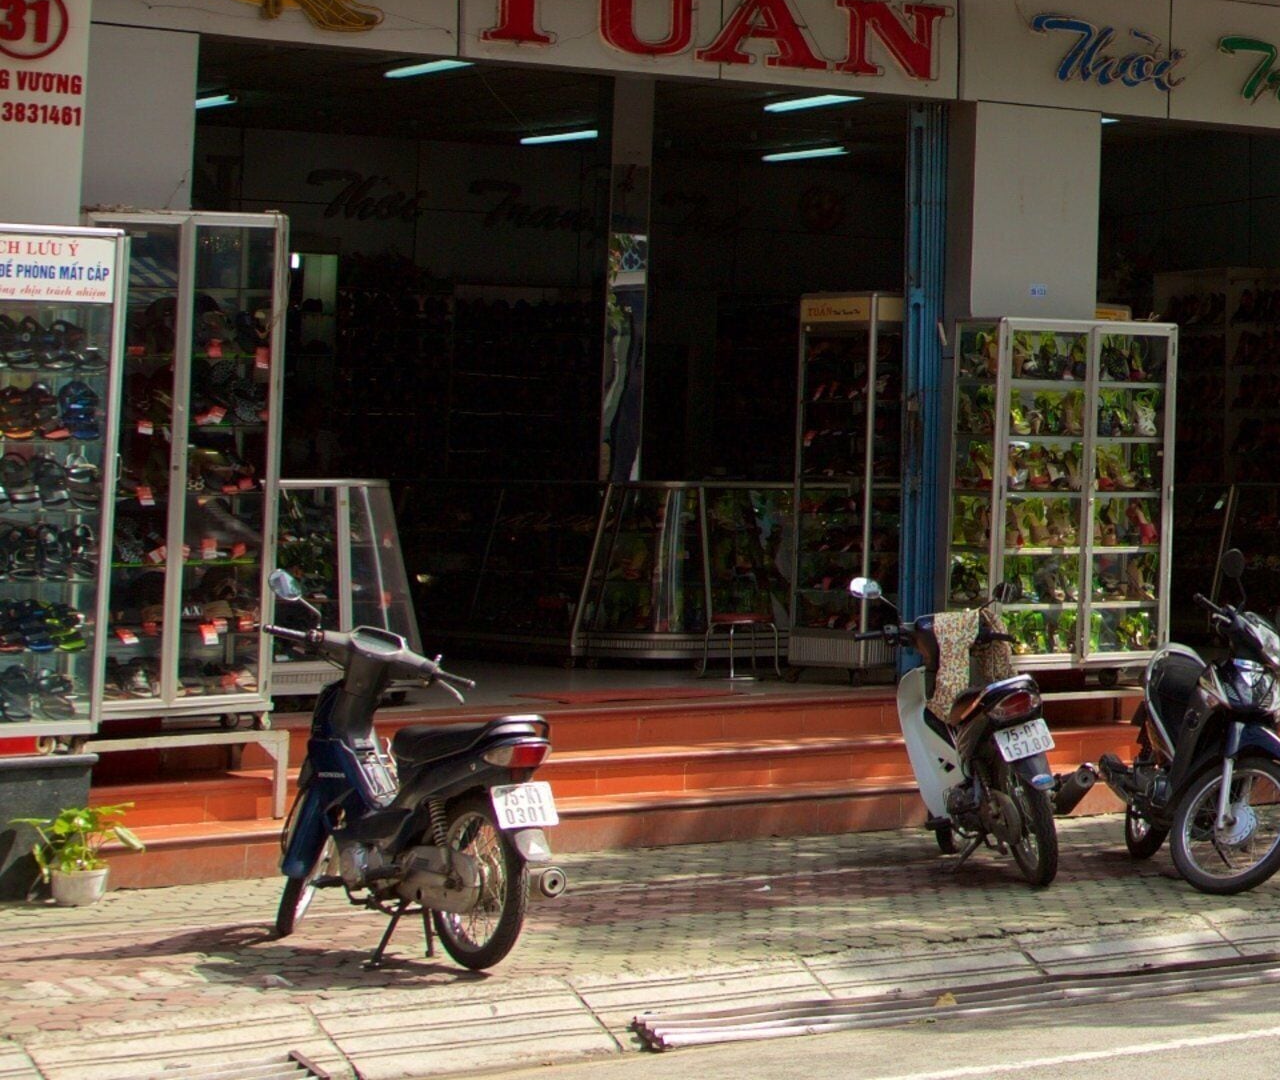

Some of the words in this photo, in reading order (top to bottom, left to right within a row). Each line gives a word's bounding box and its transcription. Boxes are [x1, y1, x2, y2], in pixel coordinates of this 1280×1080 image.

[1029, 10, 1189, 94] Thời
[16, 70, 83, 96] VƯƠNG
[1, 101, 83, 127] 3831461
[27, 240, 62, 256] LƯU
[68, 240, 79, 256] Ý
[16, 261, 56, 279] PHÒNG
[59, 261, 84, 281] MẤT
[504, 806, 548, 825] 0301
